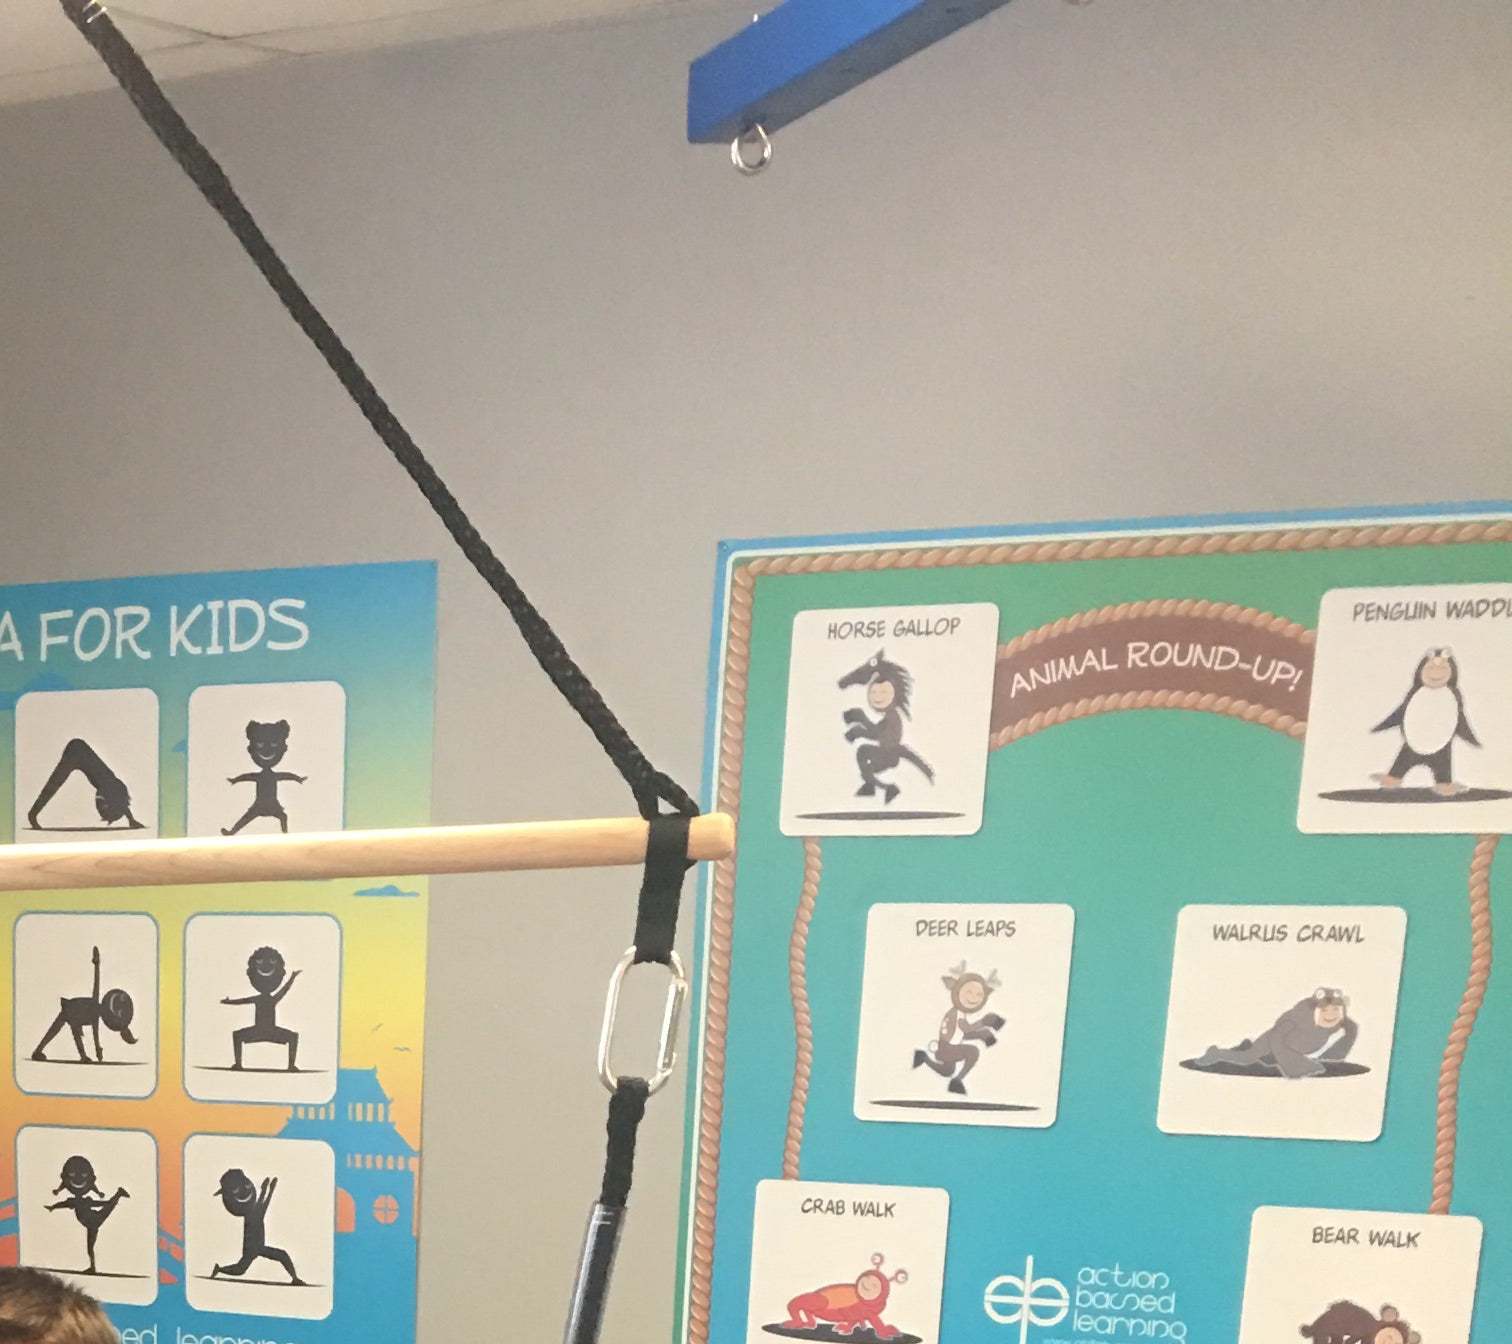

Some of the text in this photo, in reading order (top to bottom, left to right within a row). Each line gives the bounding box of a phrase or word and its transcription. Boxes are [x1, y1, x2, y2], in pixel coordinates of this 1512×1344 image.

[1352, 600, 1437, 622] PENGUIN
[39, 605, 152, 662] FOR
[169, 597, 310, 657] KIDS
[827, 616, 961, 641] HORSE GALLOP
[1009, 641, 1304, 699] ANIMAL ROUND-UP!
[916, 920, 1016, 937] DEER LEAPS
[1213, 924, 1366, 943] WALRUS CRAWL
[801, 1198, 896, 1218] CRAB WALK
[1312, 1226, 1421, 1248] BEAR WALK
[1078, 1263, 1170, 1290] action
[1076, 1285, 1176, 1314] based
